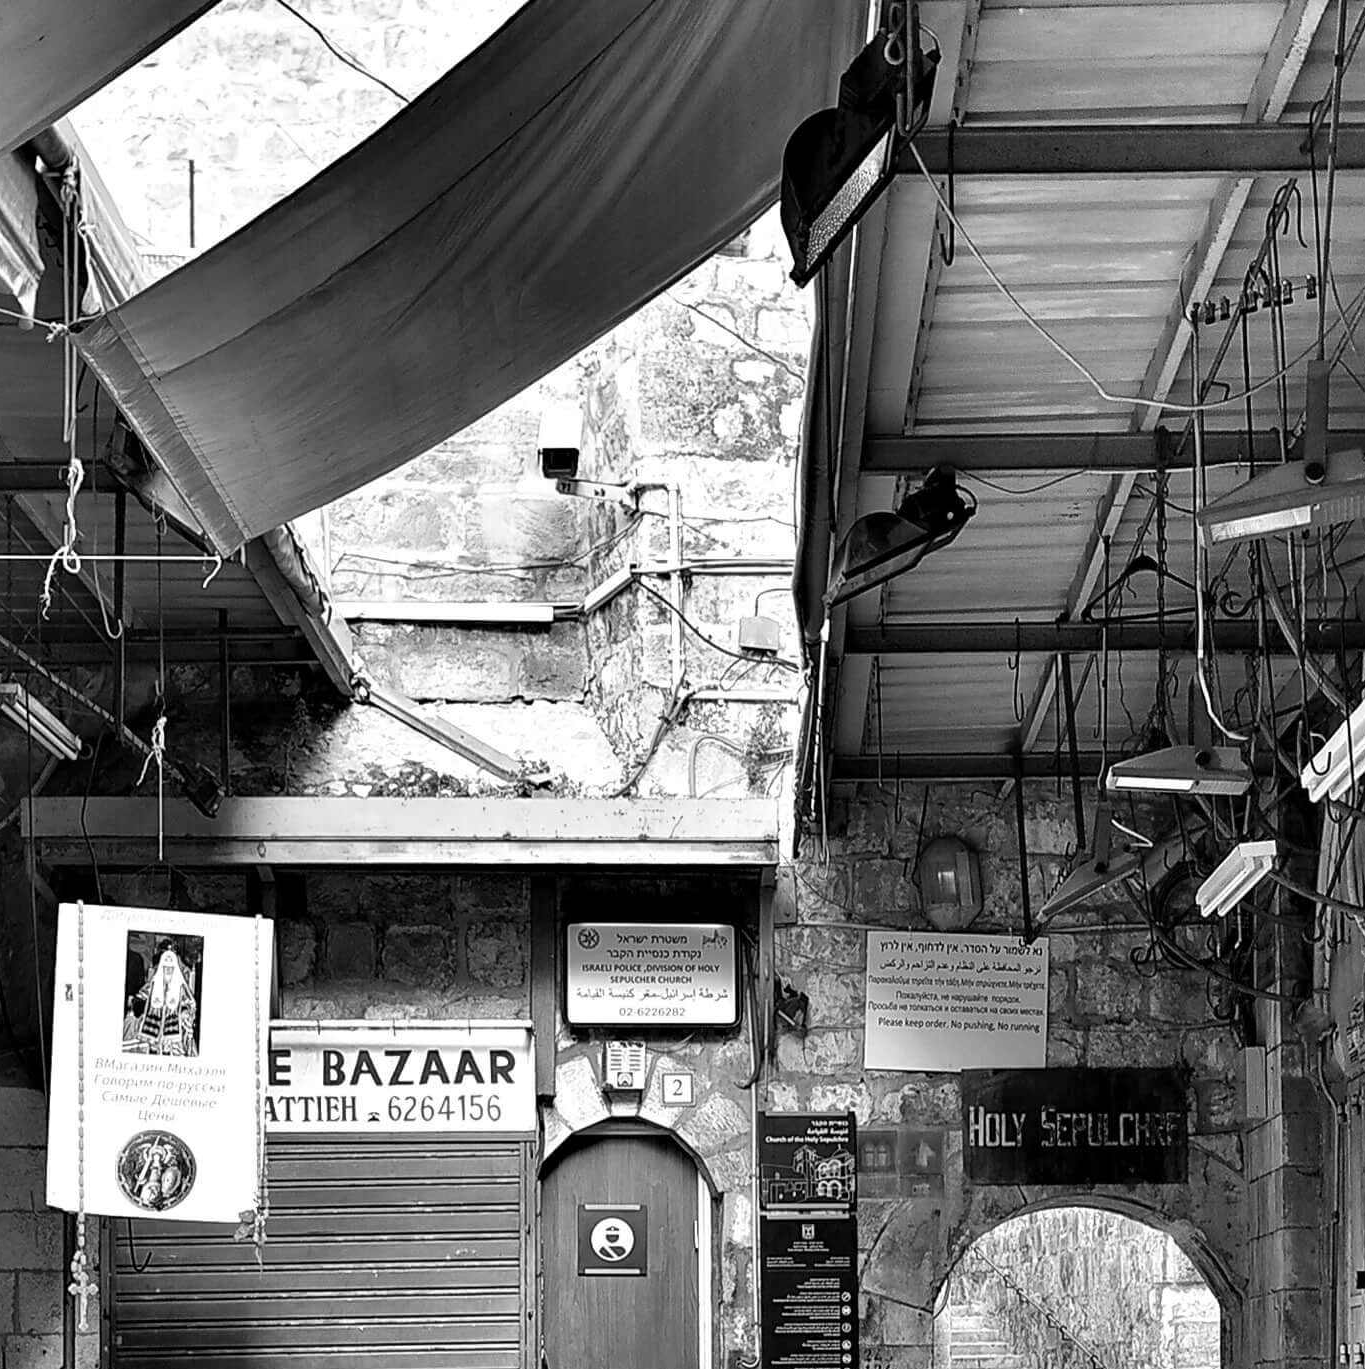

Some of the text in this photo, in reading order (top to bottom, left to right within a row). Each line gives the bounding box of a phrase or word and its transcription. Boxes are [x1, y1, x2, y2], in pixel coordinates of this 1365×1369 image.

[616, 933, 648, 944] ישראל
[651, 934, 688, 945] משטרת
[879, 940, 899, 953] לרוץ
[900, 942, 914, 953] אין
[946, 943, 959, 955] אין
[990, 943, 1001, 955] על
[606, 949, 702, 961] נקודת כנסיית הקבר
[581, 964, 613, 973] ISRAELI
[614, 964, 642, 973] POLICE
[684, 964, 696, 973] OF
[698, 964, 721, 973] HOLY
[610, 975, 693, 984] SEPULCHER CHURCH
[576, 986, 605, 1001] القيامة
[608, 986, 636, 1001] كنيسة
[699, 987, 729, 1002] شرطة
[618, 1007, 686, 1017] 02-6226282
[868, 1000, 898, 1011] Просьба
[878, 1016, 904, 1027] Please
[905, 1017, 924, 1029] keep
[951, 1019, 963, 1029] No
[997, 1021, 1009, 1031] No
[1010, 1022, 1041, 1034] running
[322, 1049, 516, 1086] BAZAAR
[94, 1073, 153, 1090] Говорим
[672, 1079, 684, 1096] 2
[101, 1090, 148, 1104] Самые
[387, 1094, 502, 1122] 6264156
[138, 1109, 176, 1123] Цены
[968, 1105, 1026, 1147] HOLY
[765, 1135, 787, 1144] Church
[794, 1135, 804, 1144] the
[804, 1135, 819, 1145] Holy
